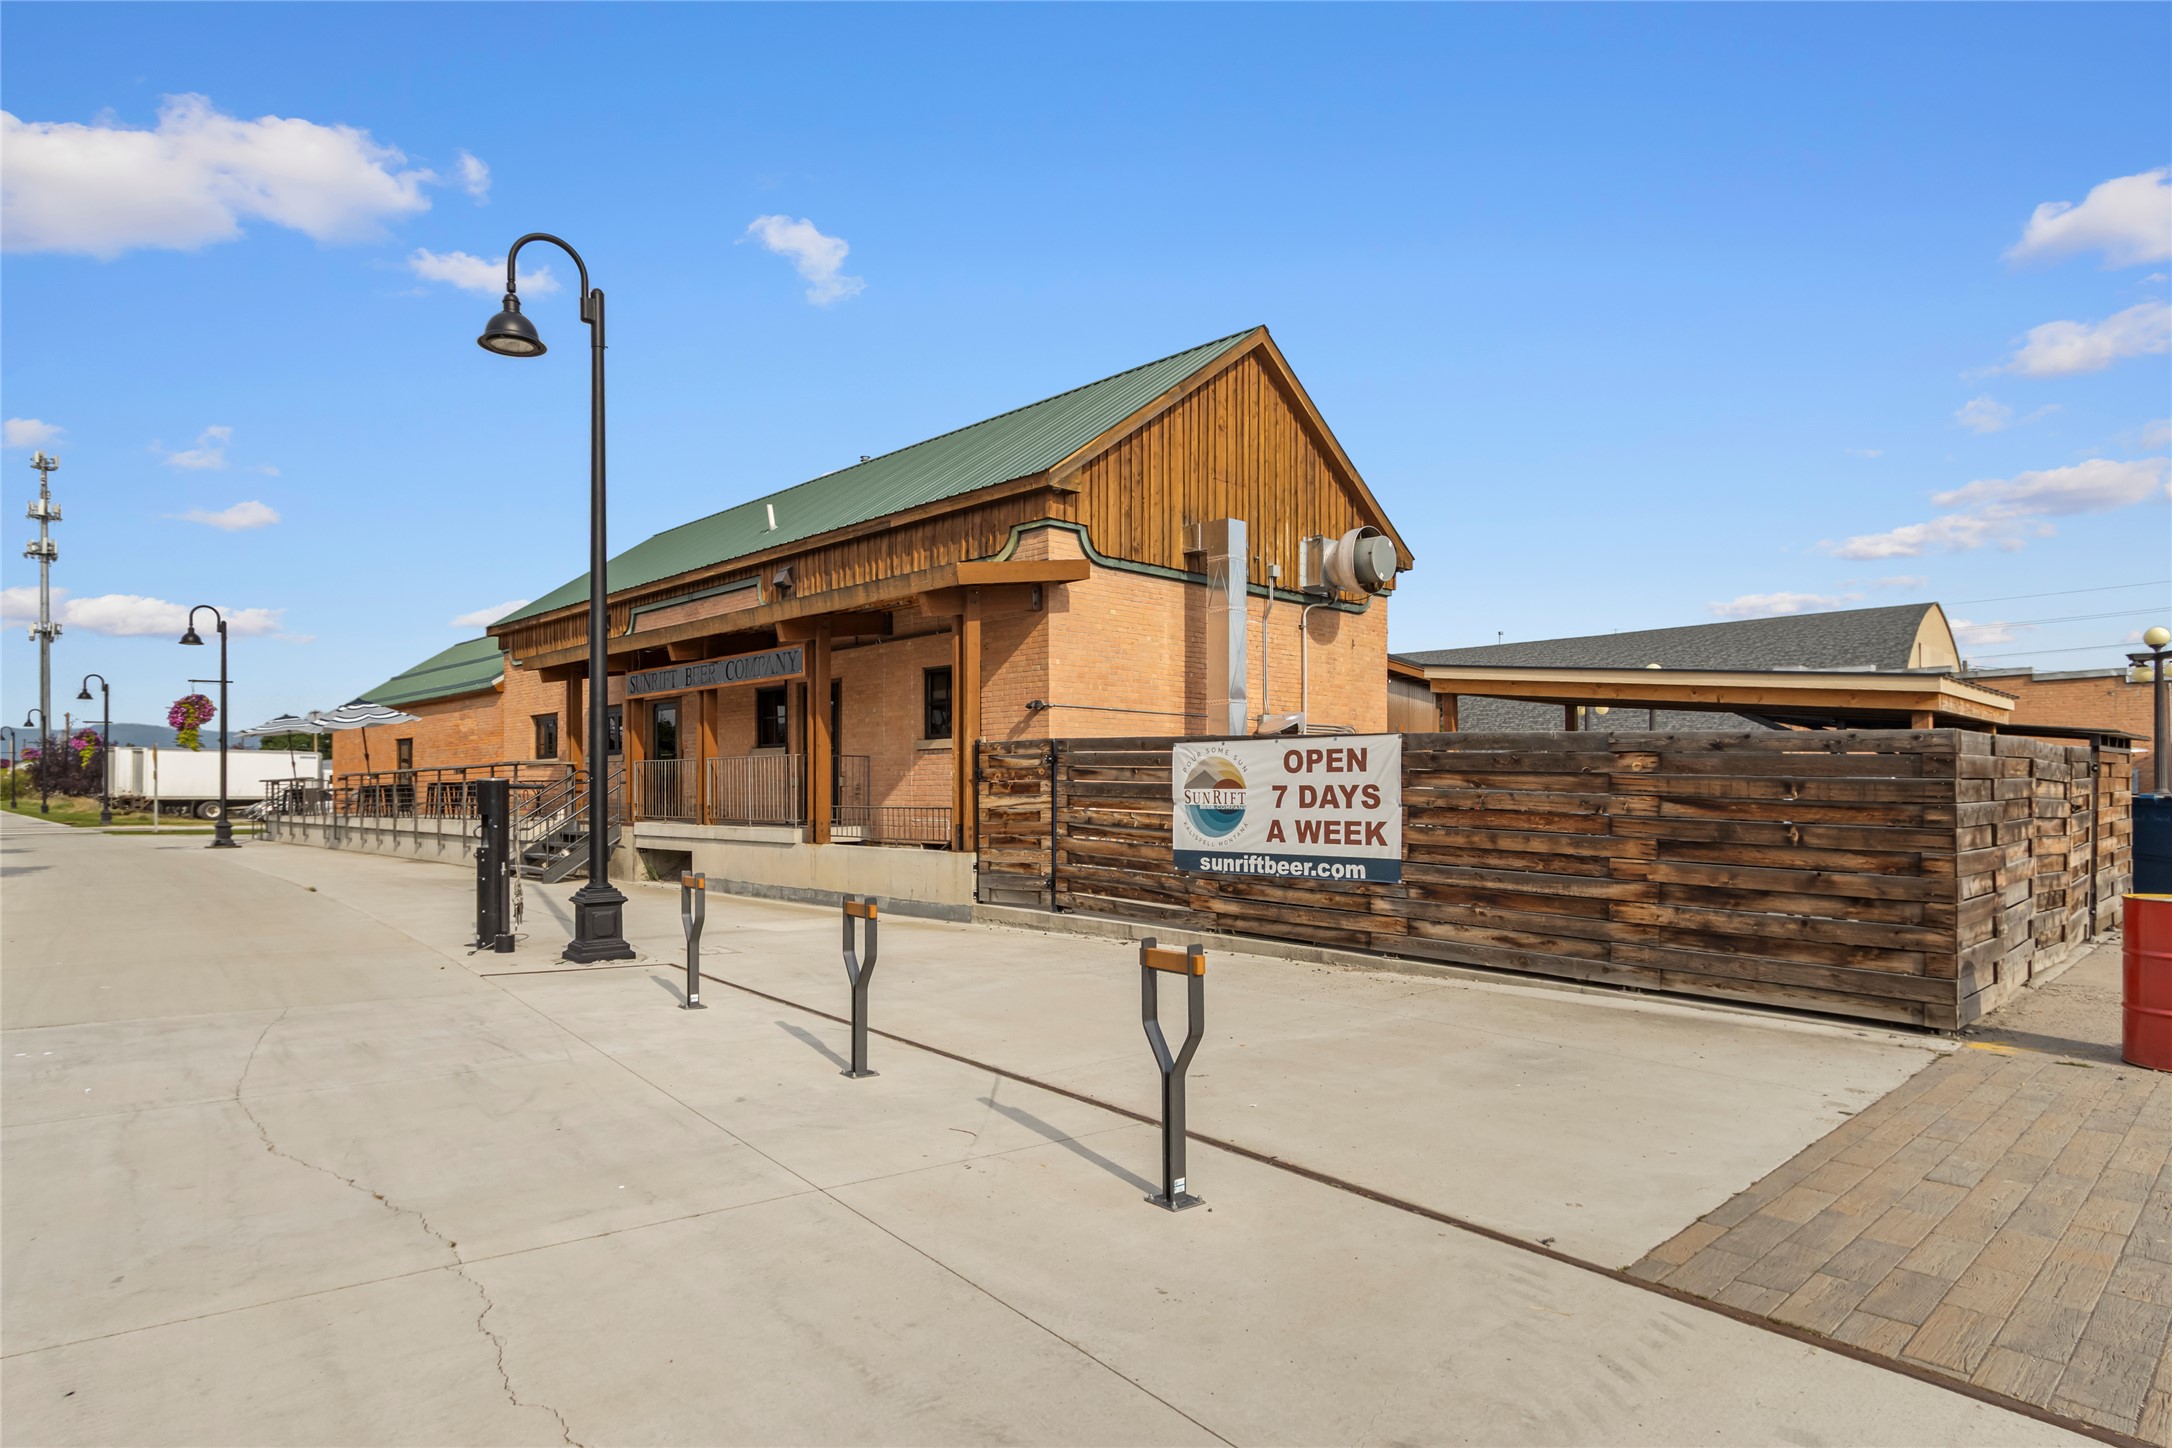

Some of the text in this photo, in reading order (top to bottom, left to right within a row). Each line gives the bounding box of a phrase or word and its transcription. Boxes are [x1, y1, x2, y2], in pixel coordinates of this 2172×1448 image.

[630, 650, 799, 694] SUNRIFT BEER COMPANY
[1182, 747, 1248, 774] POUR SOME SUN
[1283, 747, 1368, 774] OPEN
[1184, 789, 1247, 805] SUNRIFT
[1272, 784, 1381, 810] 7 DAYS
[1183, 821, 1249, 847] KALISPELL MONTANA
[1266, 819, 1388, 847] A WEEK
[1200, 854, 1366, 880] sunriftbeer.com
